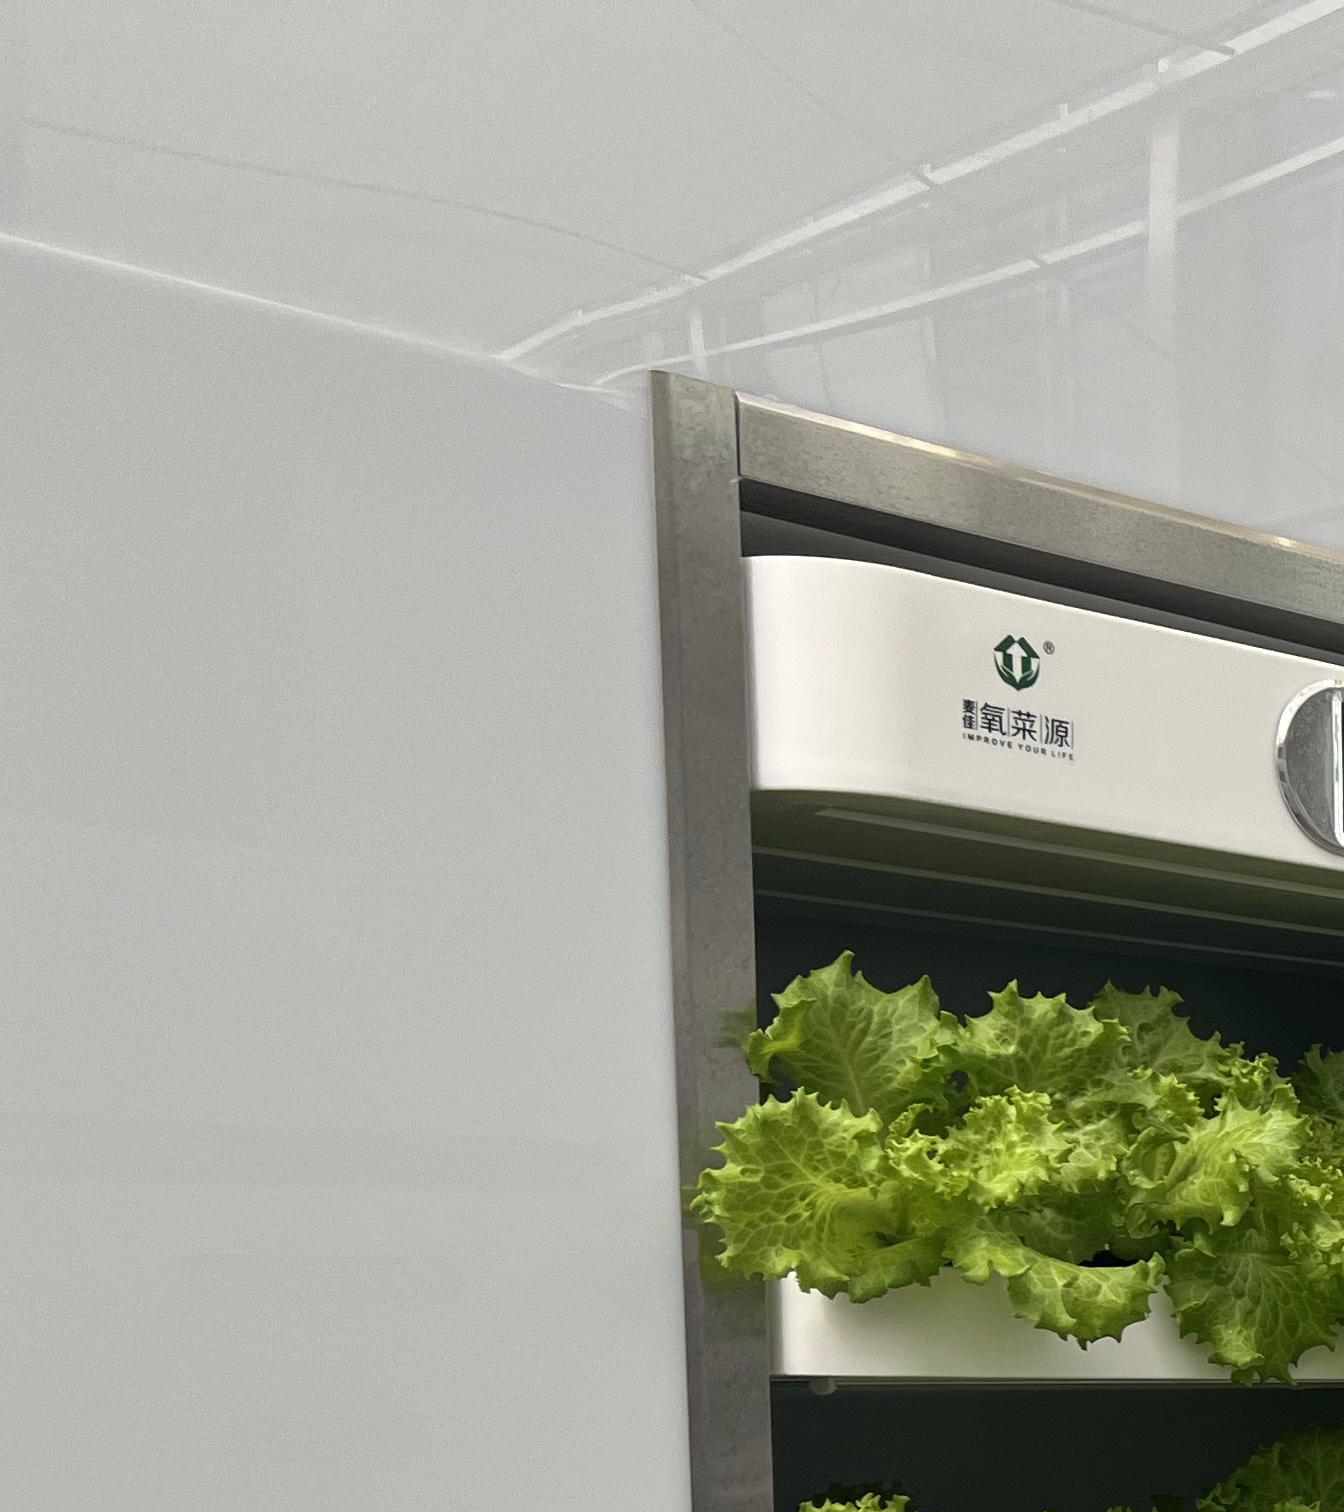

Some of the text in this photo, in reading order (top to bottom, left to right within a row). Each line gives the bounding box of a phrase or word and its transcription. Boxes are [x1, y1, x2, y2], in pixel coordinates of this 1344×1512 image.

[962, 733, 1075, 761] IMPROVE YOUR LIFE
